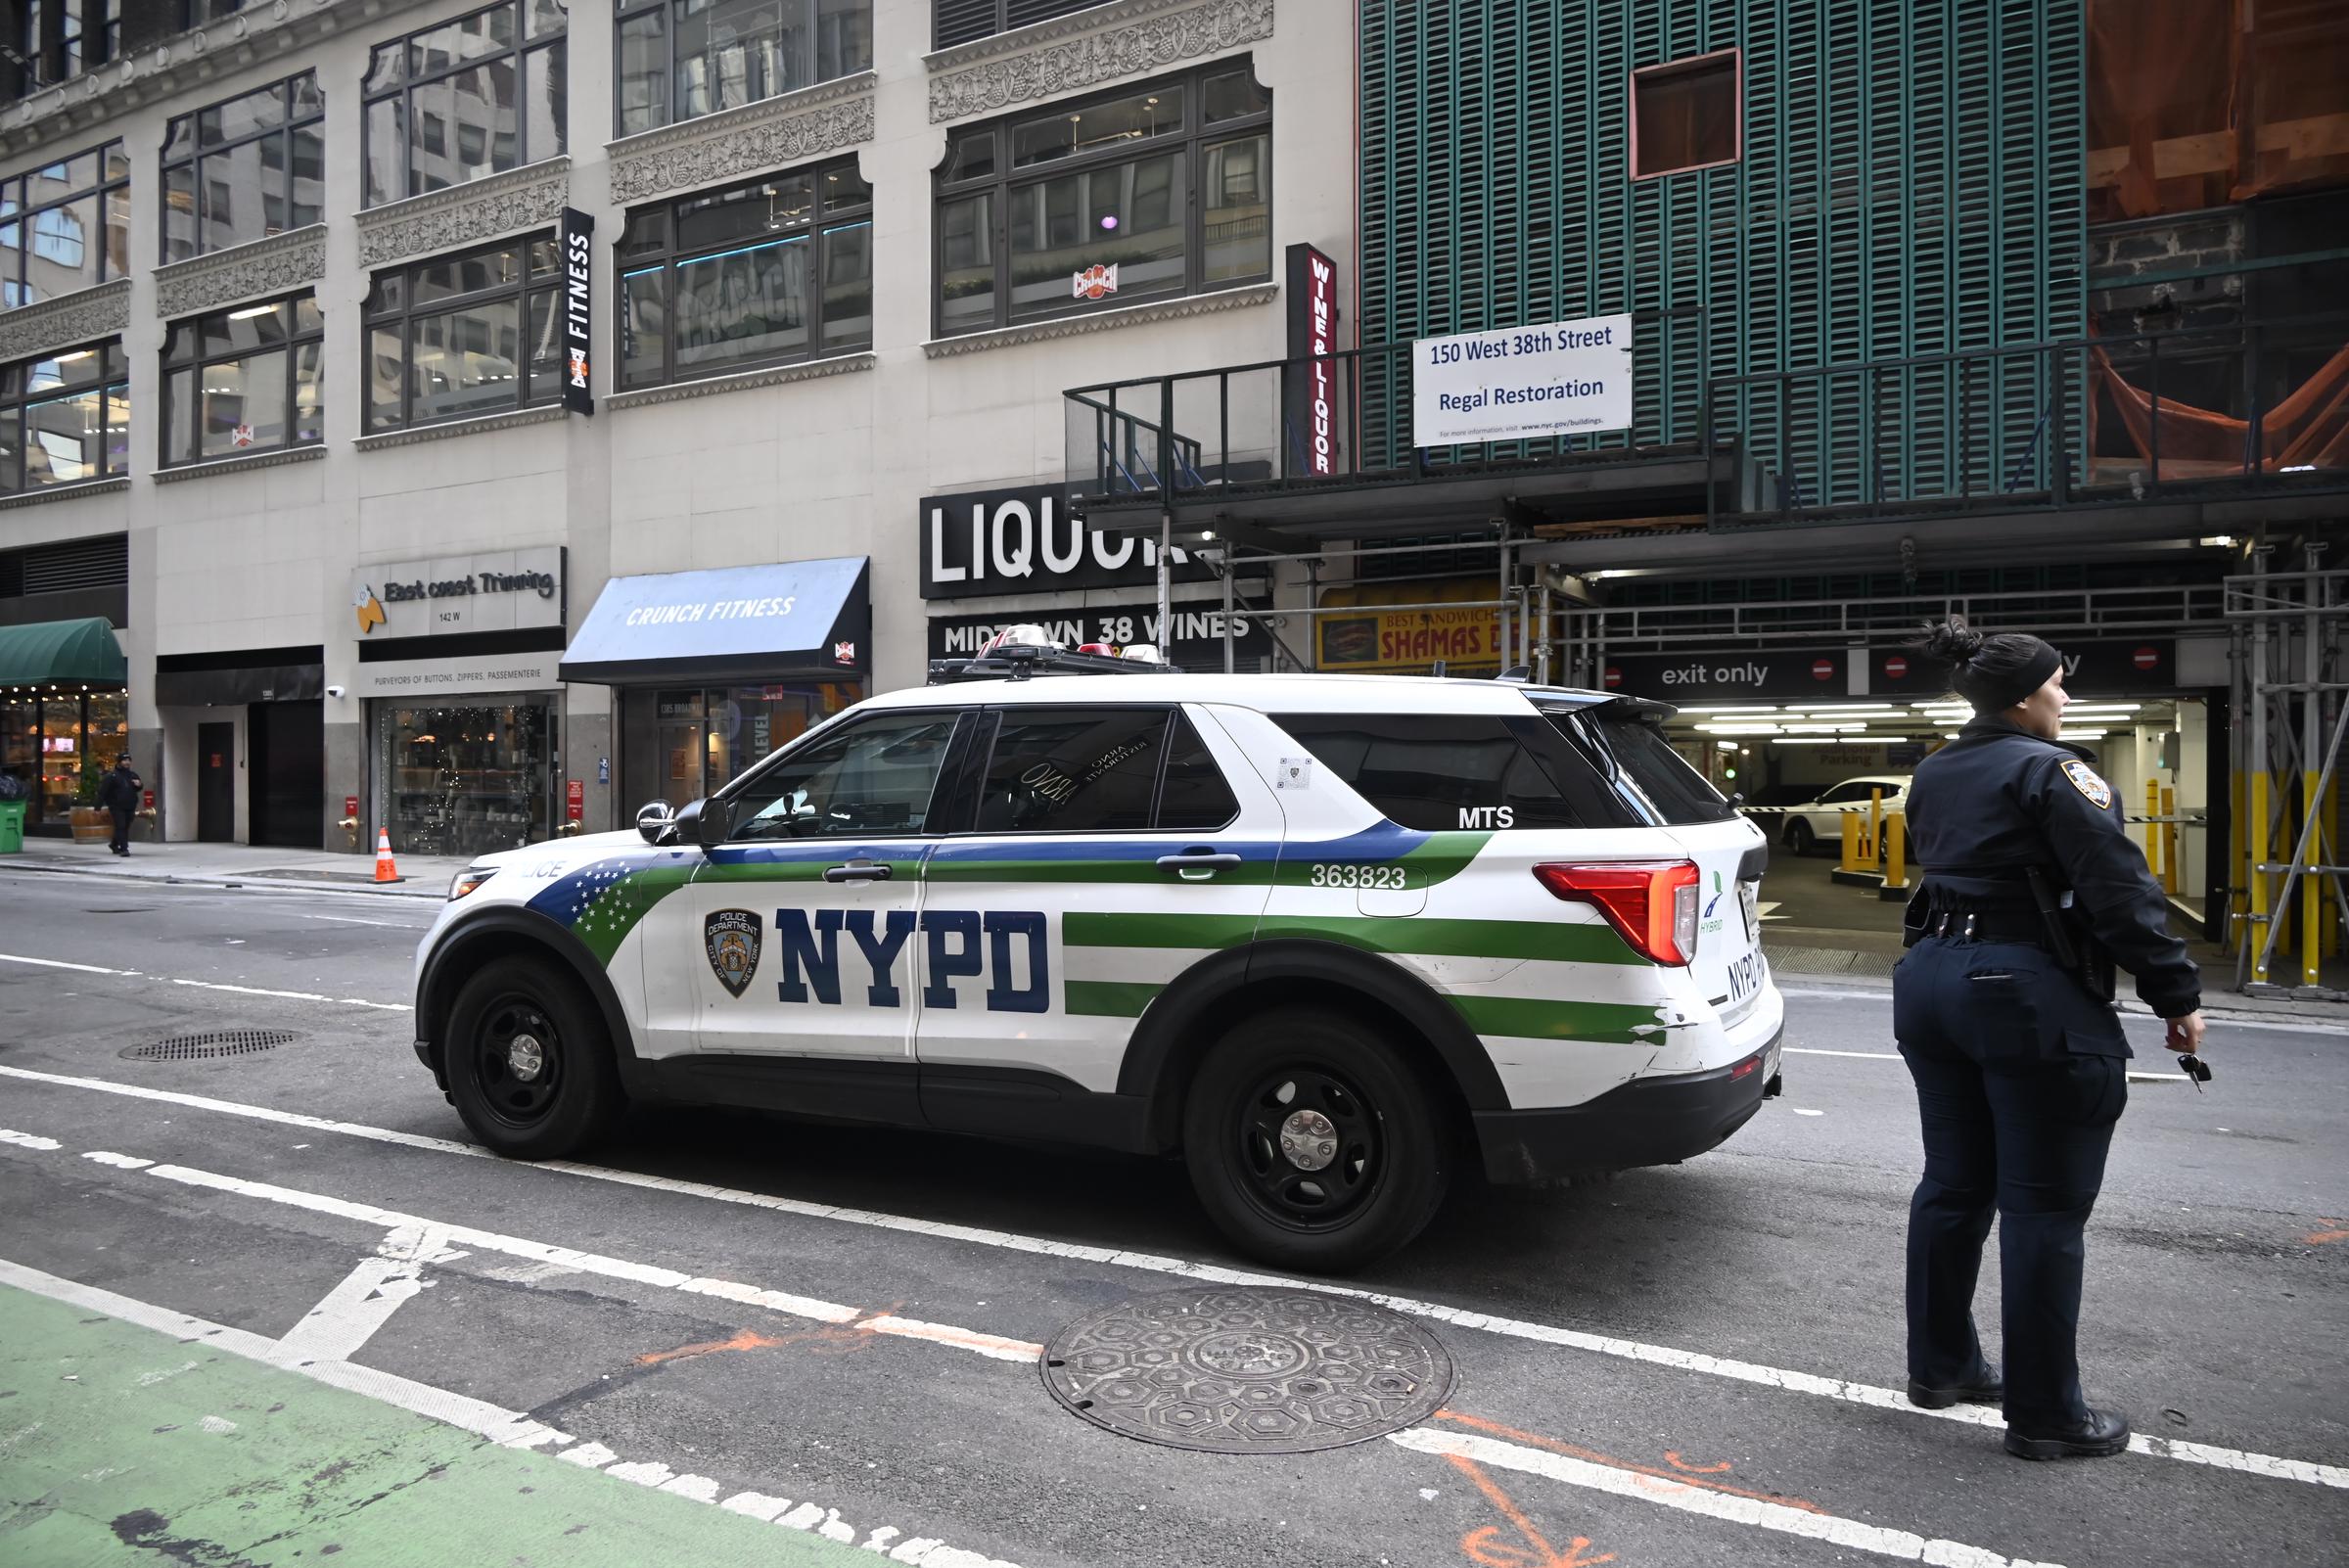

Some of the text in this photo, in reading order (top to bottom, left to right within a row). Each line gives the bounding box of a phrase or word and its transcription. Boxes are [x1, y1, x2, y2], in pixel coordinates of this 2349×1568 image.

[569, 232, 589, 340] FITNESS
[1312, 257, 1329, 338] WINE
[1431, 326, 1612, 365] 150 West 38th Street
[1440, 380, 1603, 412] Regal Restoration
[1314, 359, 1329, 474] LIQUOR
[385, 570, 555, 602] East coast Trimming
[439, 612, 460, 623] 142 W
[626, 596, 796, 626] CRUNCH FITNESS
[1098, 617, 1133, 643] 38
[1143, 609, 1250, 642] WINES
[1387, 614, 1414, 627] BEST
[1382, 624, 1481, 662] SHAMAS
[375, 676, 410, 685] PURVEYORS
[413, 674, 422, 684] OF
[487, 669, 541, 680] PASSEMENTERIE
[1662, 662, 1769, 687] exit only
[754, 713, 770, 756] LEVEL
[1458, 807, 1514, 829] MTS
[1311, 863, 1405, 891] 363823
[708, 920, 759, 936] DEPARTMENT
[719, 912, 748, 922] POLICE
[1700, 919, 1724, 934] HYBRID
[708, 945, 727, 979] CITY OF
[743, 943, 760, 984] NEW YORK
[775, 907, 1050, 1014] NYPD
[1727, 952, 1757, 1002] NYPD
